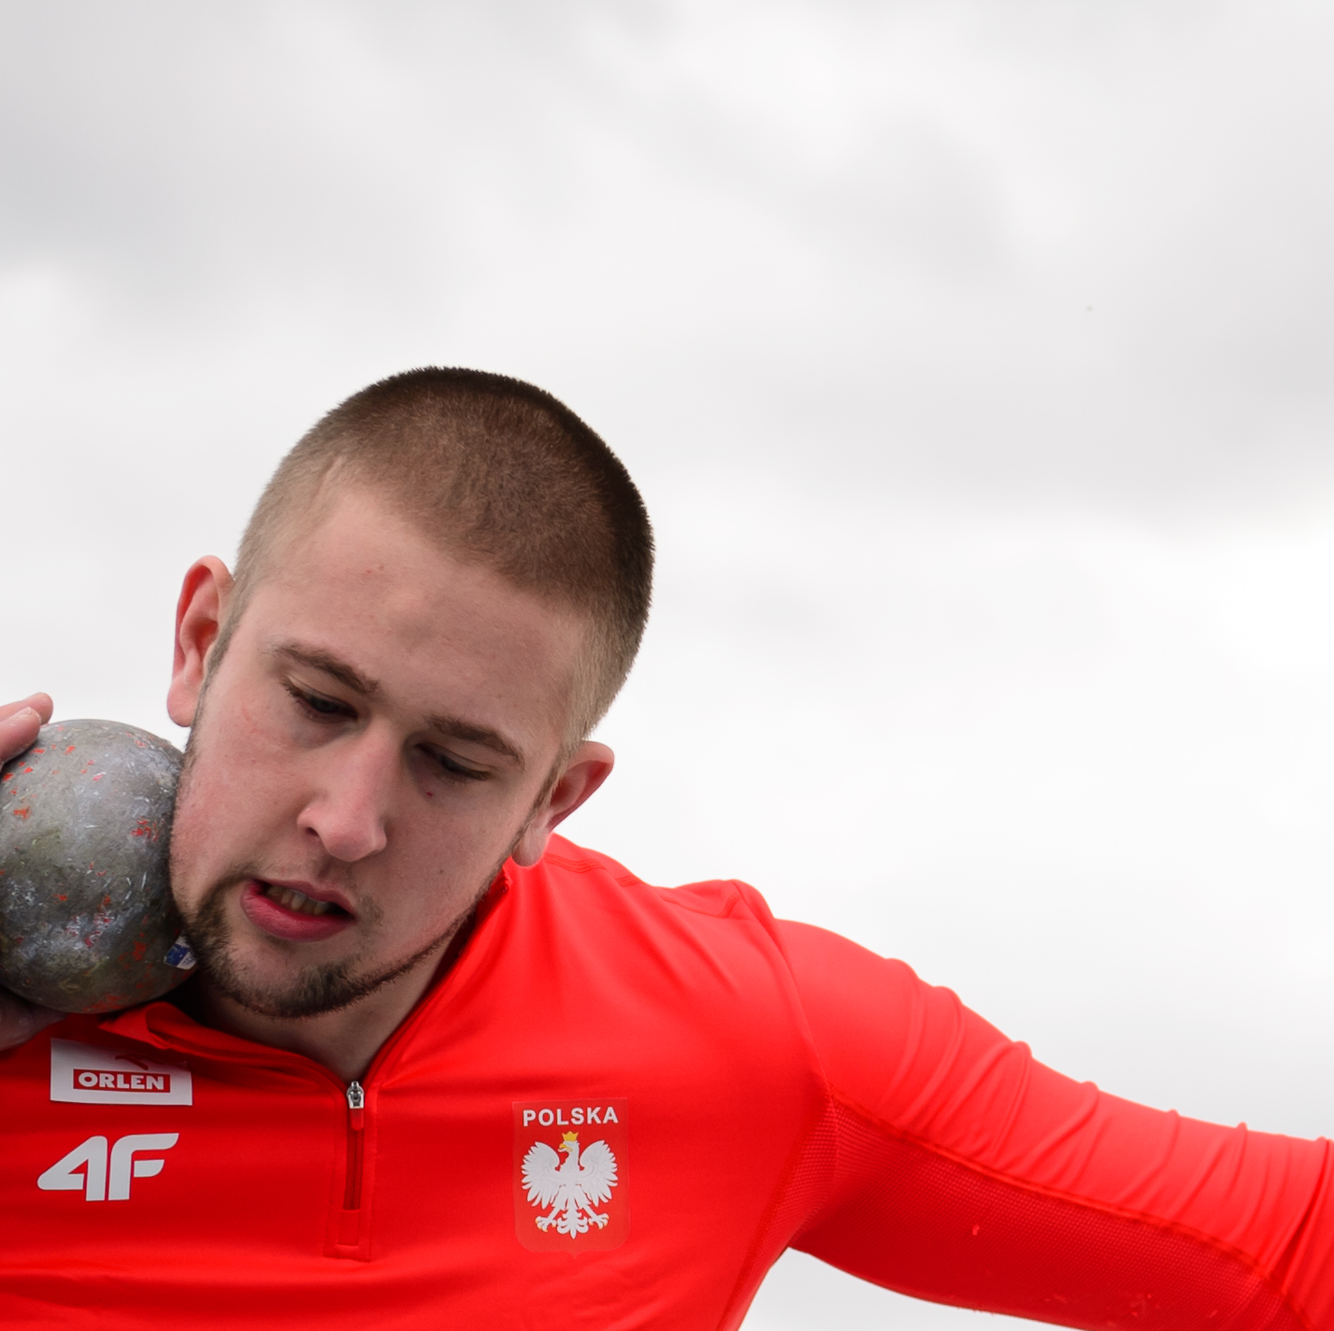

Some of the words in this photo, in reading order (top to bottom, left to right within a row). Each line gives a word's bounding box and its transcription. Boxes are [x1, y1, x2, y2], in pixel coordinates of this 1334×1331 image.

[78, 1071, 165, 1091] ORLEN
[522, 1106, 619, 1127] POLSKA
[37, 1132, 180, 1202] 4F
